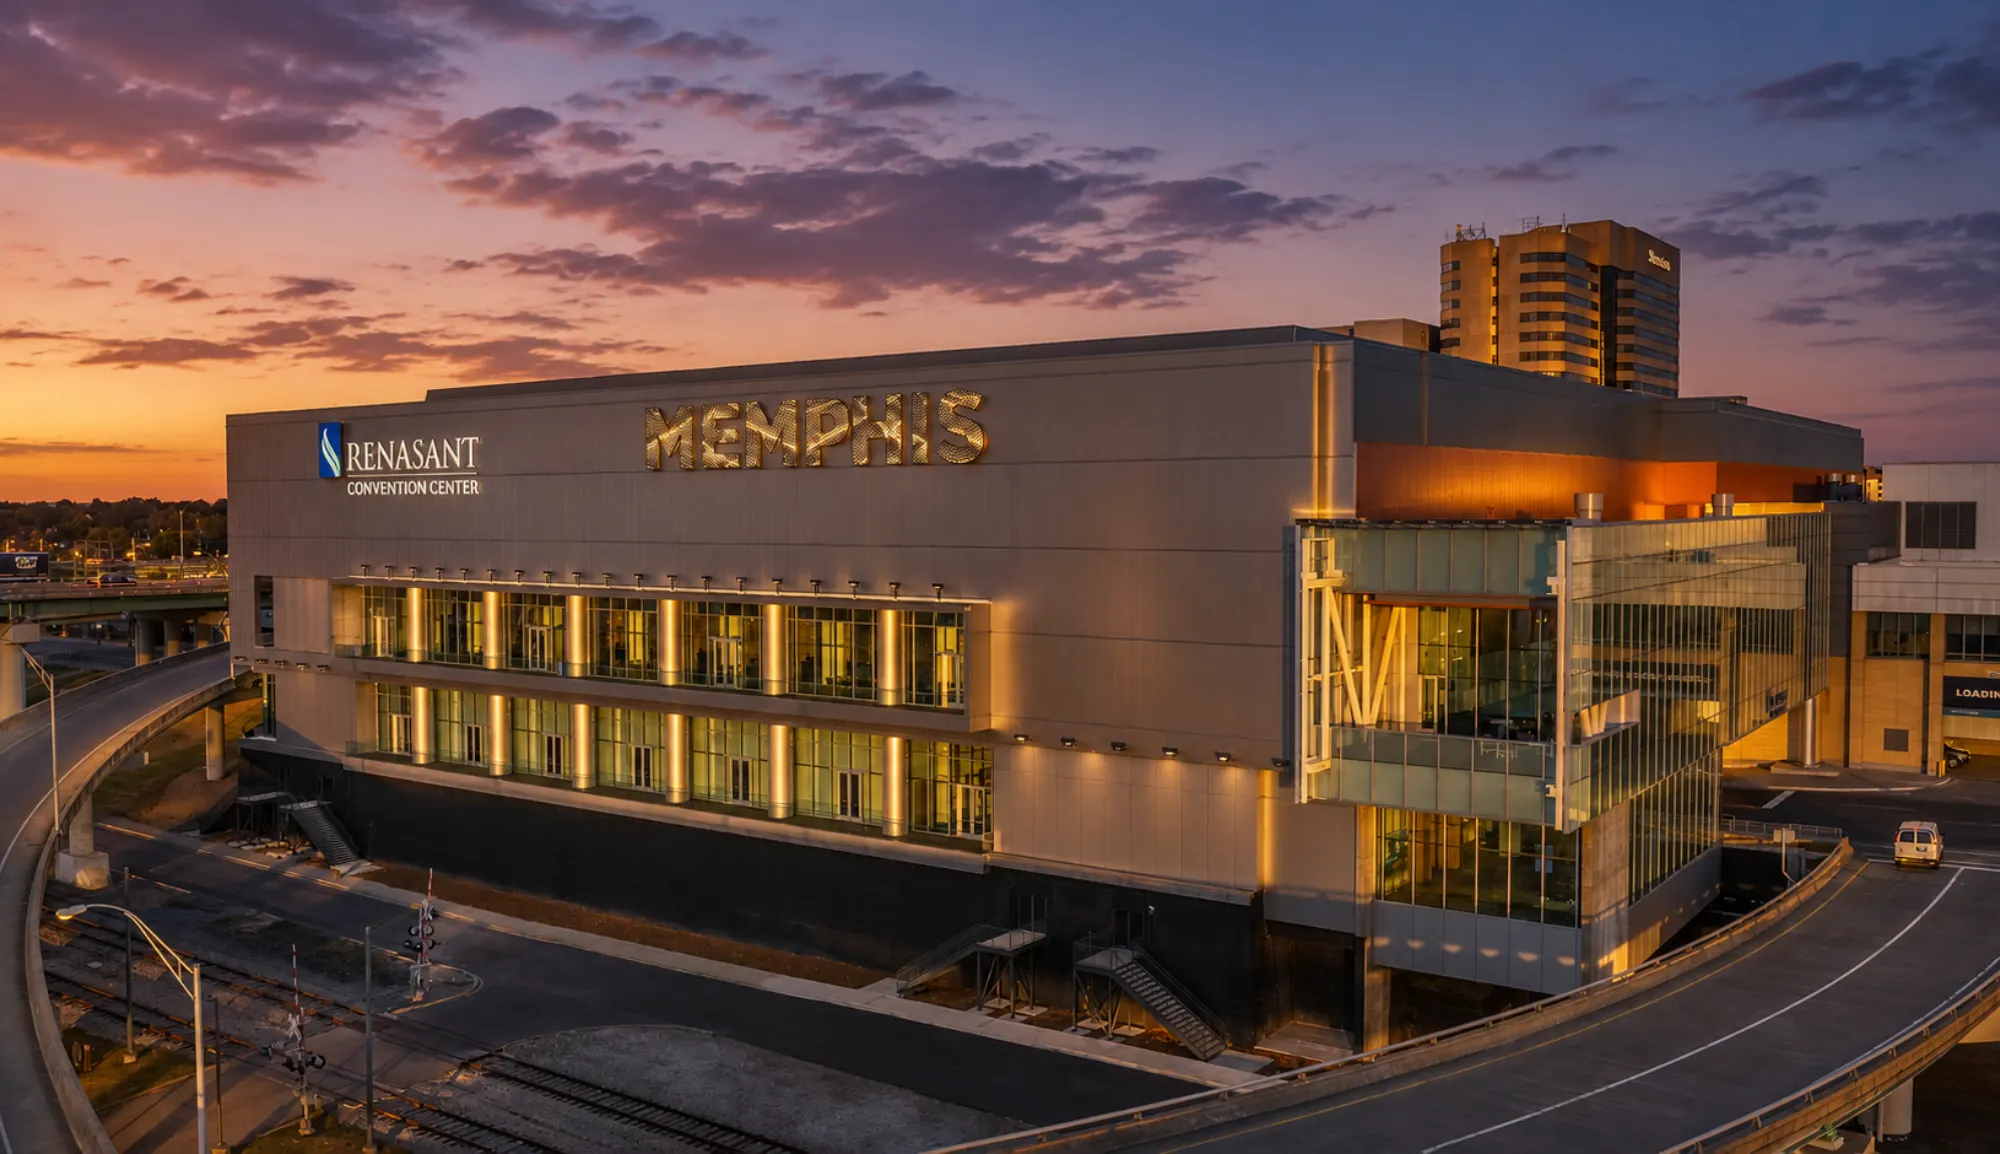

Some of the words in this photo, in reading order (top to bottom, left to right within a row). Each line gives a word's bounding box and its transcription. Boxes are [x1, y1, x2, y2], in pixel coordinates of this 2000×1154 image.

[645, 388, 985, 470] MEMPHIS
[346, 437, 479, 470] RENASANT
[347, 481, 427, 495] CONVENTION
[429, 480, 479, 495] CENTER
